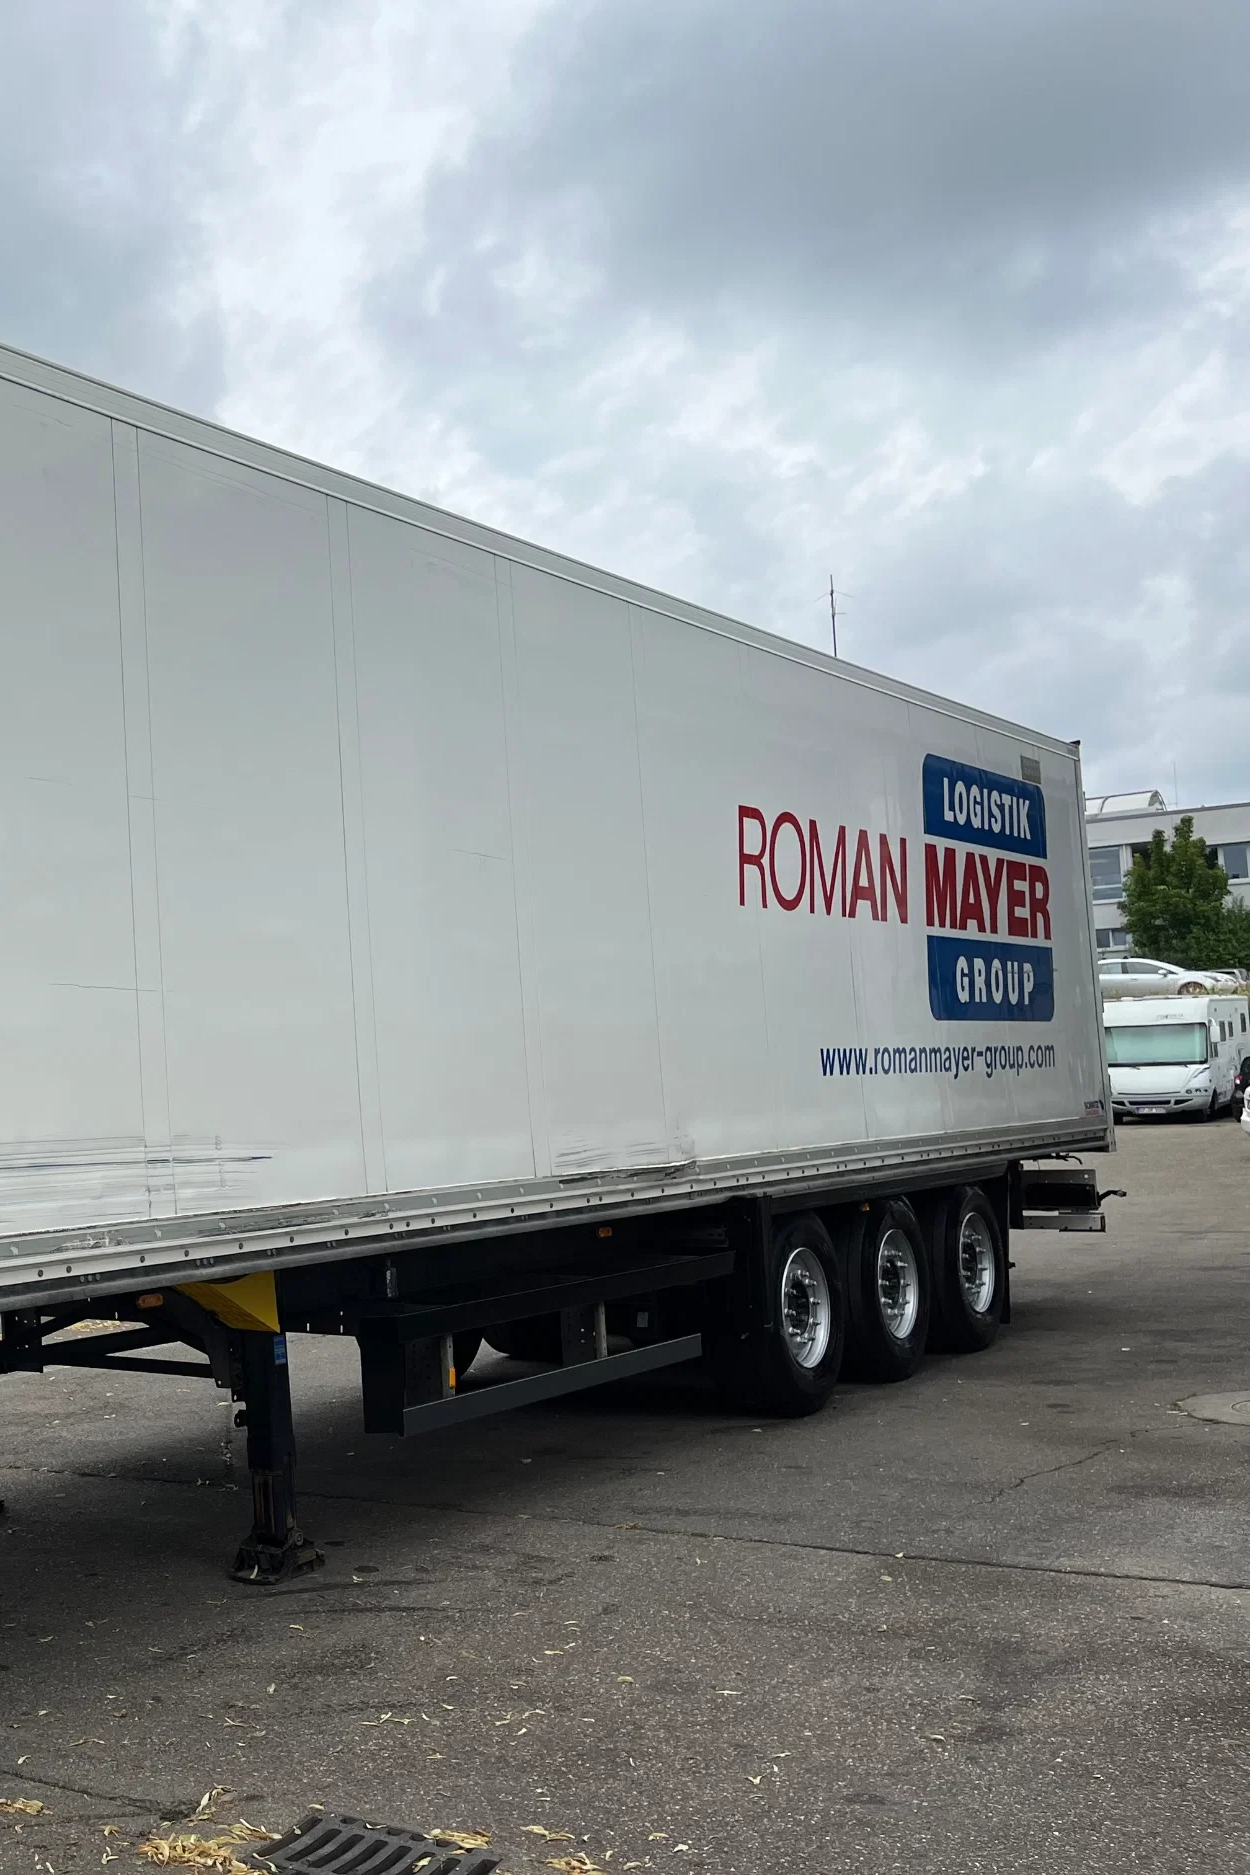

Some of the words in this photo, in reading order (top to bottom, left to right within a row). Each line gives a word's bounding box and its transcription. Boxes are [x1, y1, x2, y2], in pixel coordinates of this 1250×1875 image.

[943, 777, 1031, 840] LOGISTIK
[738, 804, 908, 924] ROMAN
[924, 843, 1051, 940] MAYER
[956, 955, 1034, 1005] GROUP
[820, 1044, 1056, 1079] www.romanmayer-group.com
